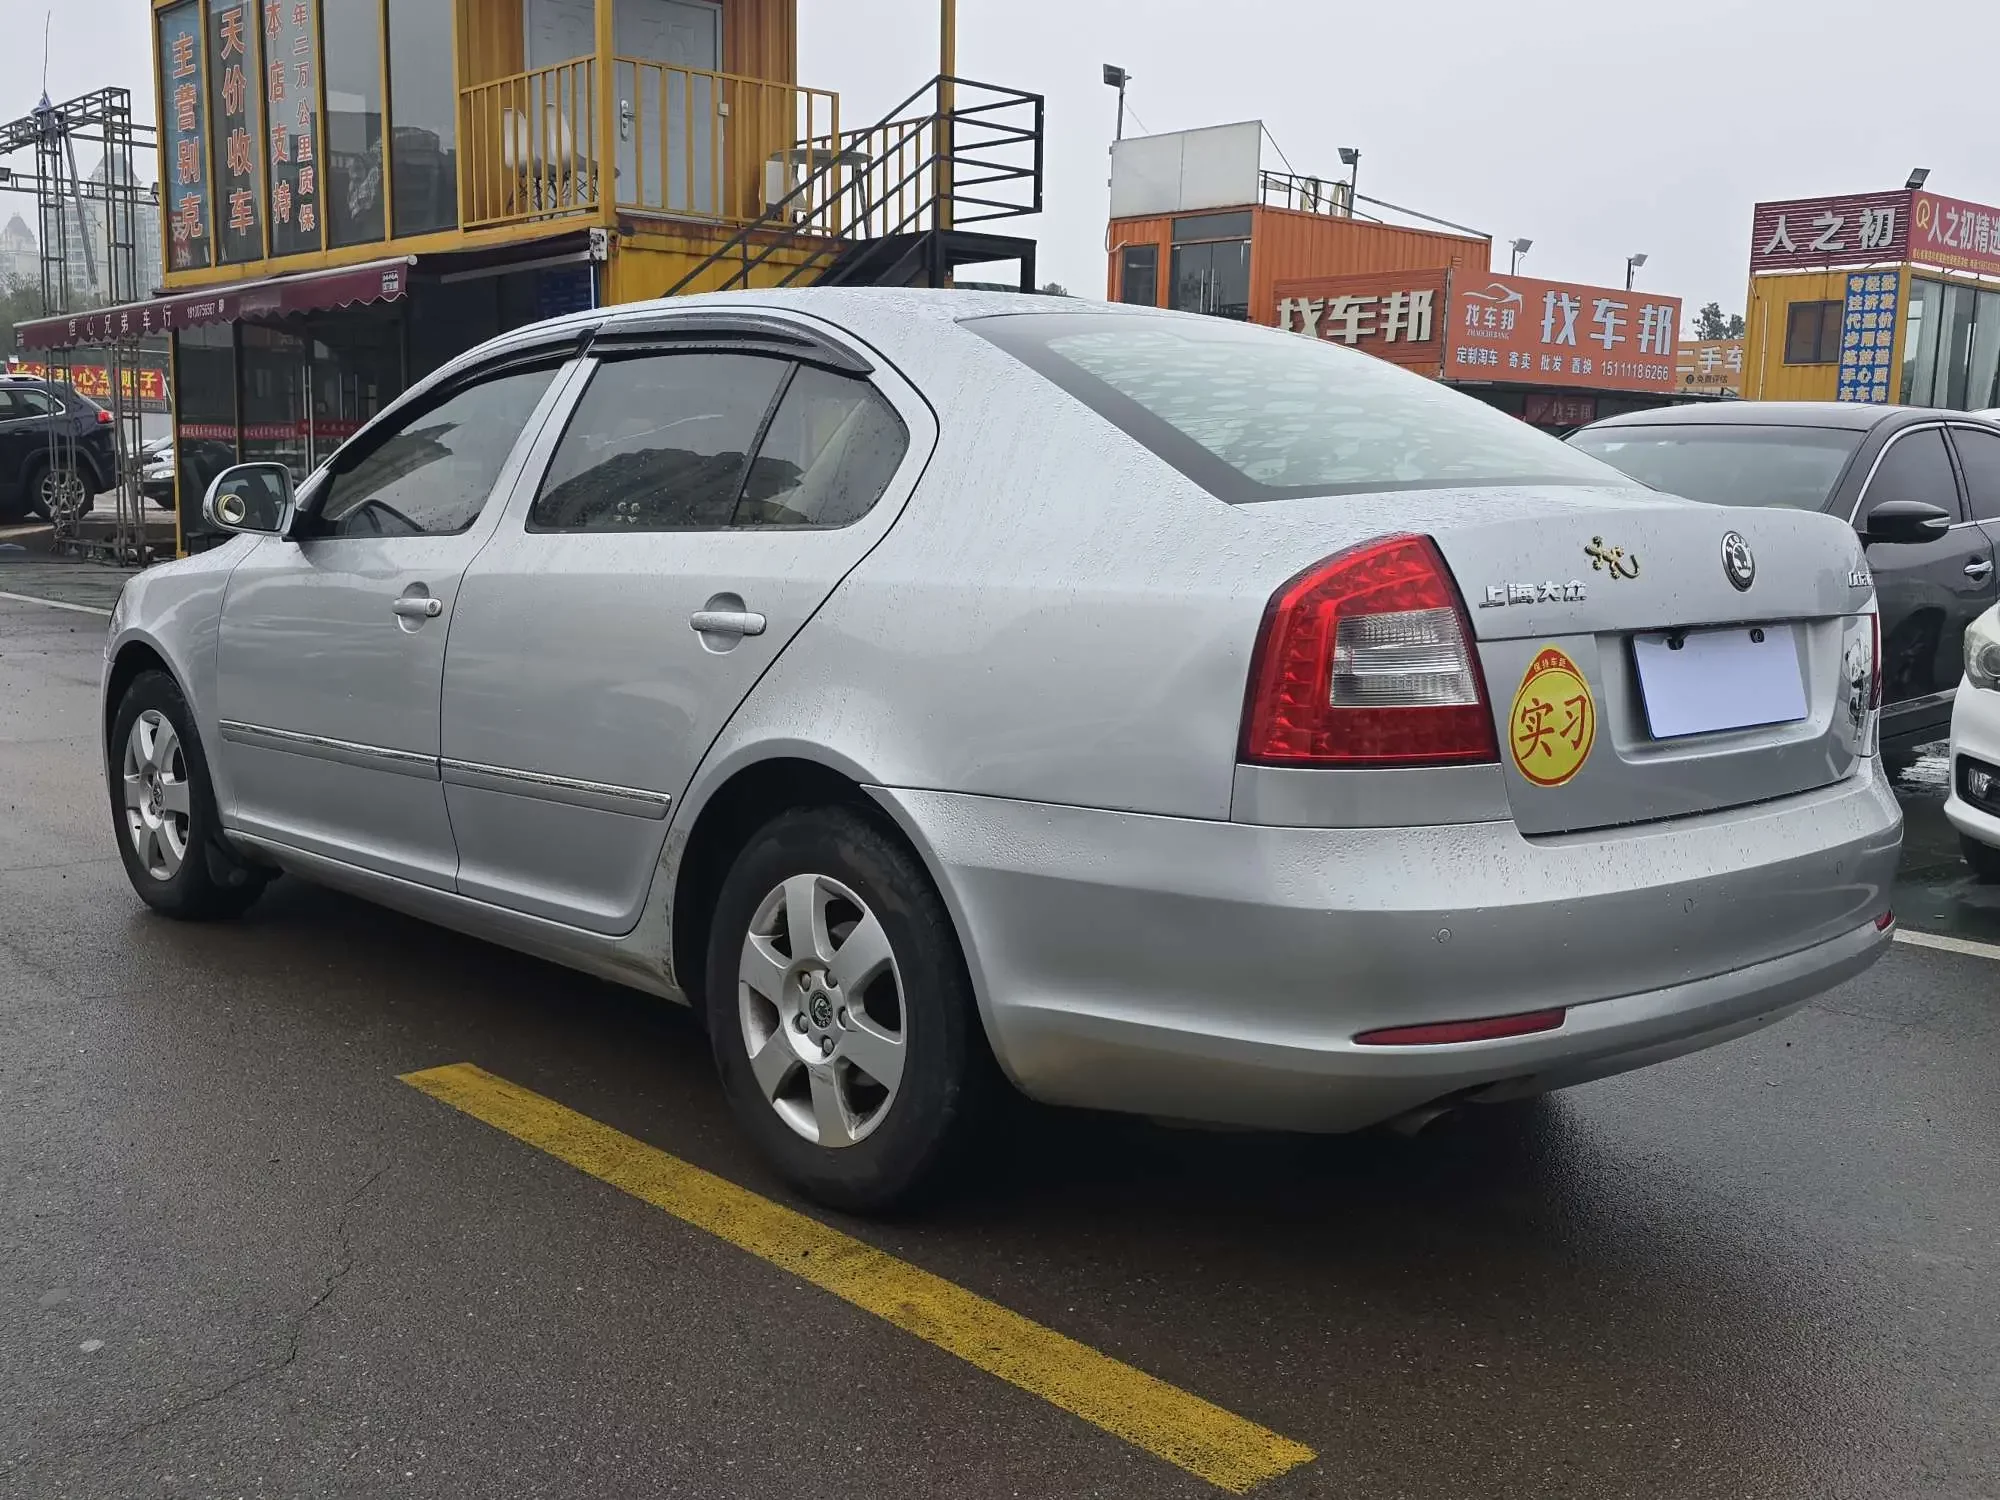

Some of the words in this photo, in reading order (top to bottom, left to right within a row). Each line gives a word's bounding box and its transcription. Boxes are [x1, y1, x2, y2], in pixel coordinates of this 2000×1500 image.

[171, 31, 203, 241] 主营别克
[219, 7, 254, 237] 天价收车
[265, 0, 292, 225] 本店支持
[1763, 207, 1896, 255] 人之初
[68, 303, 173, 337] 恒心兄弟车行
[1276, 288, 1436, 344] 找车邦
[1465, 303, 1516, 330] 找车邦
[1541, 288, 1675, 356] 找车邦
[1509, 351, 1532, 370] 寄卖
[1540, 353, 1562, 372] 批发
[1571, 356, 1593, 375] 置换
[1676, 344, 1743, 374] 二手车
[1479, 578, 1587, 608] 上海大众
[1533, 657, 1567, 673] 保持车距
[1519, 694, 1587, 761] 实习
